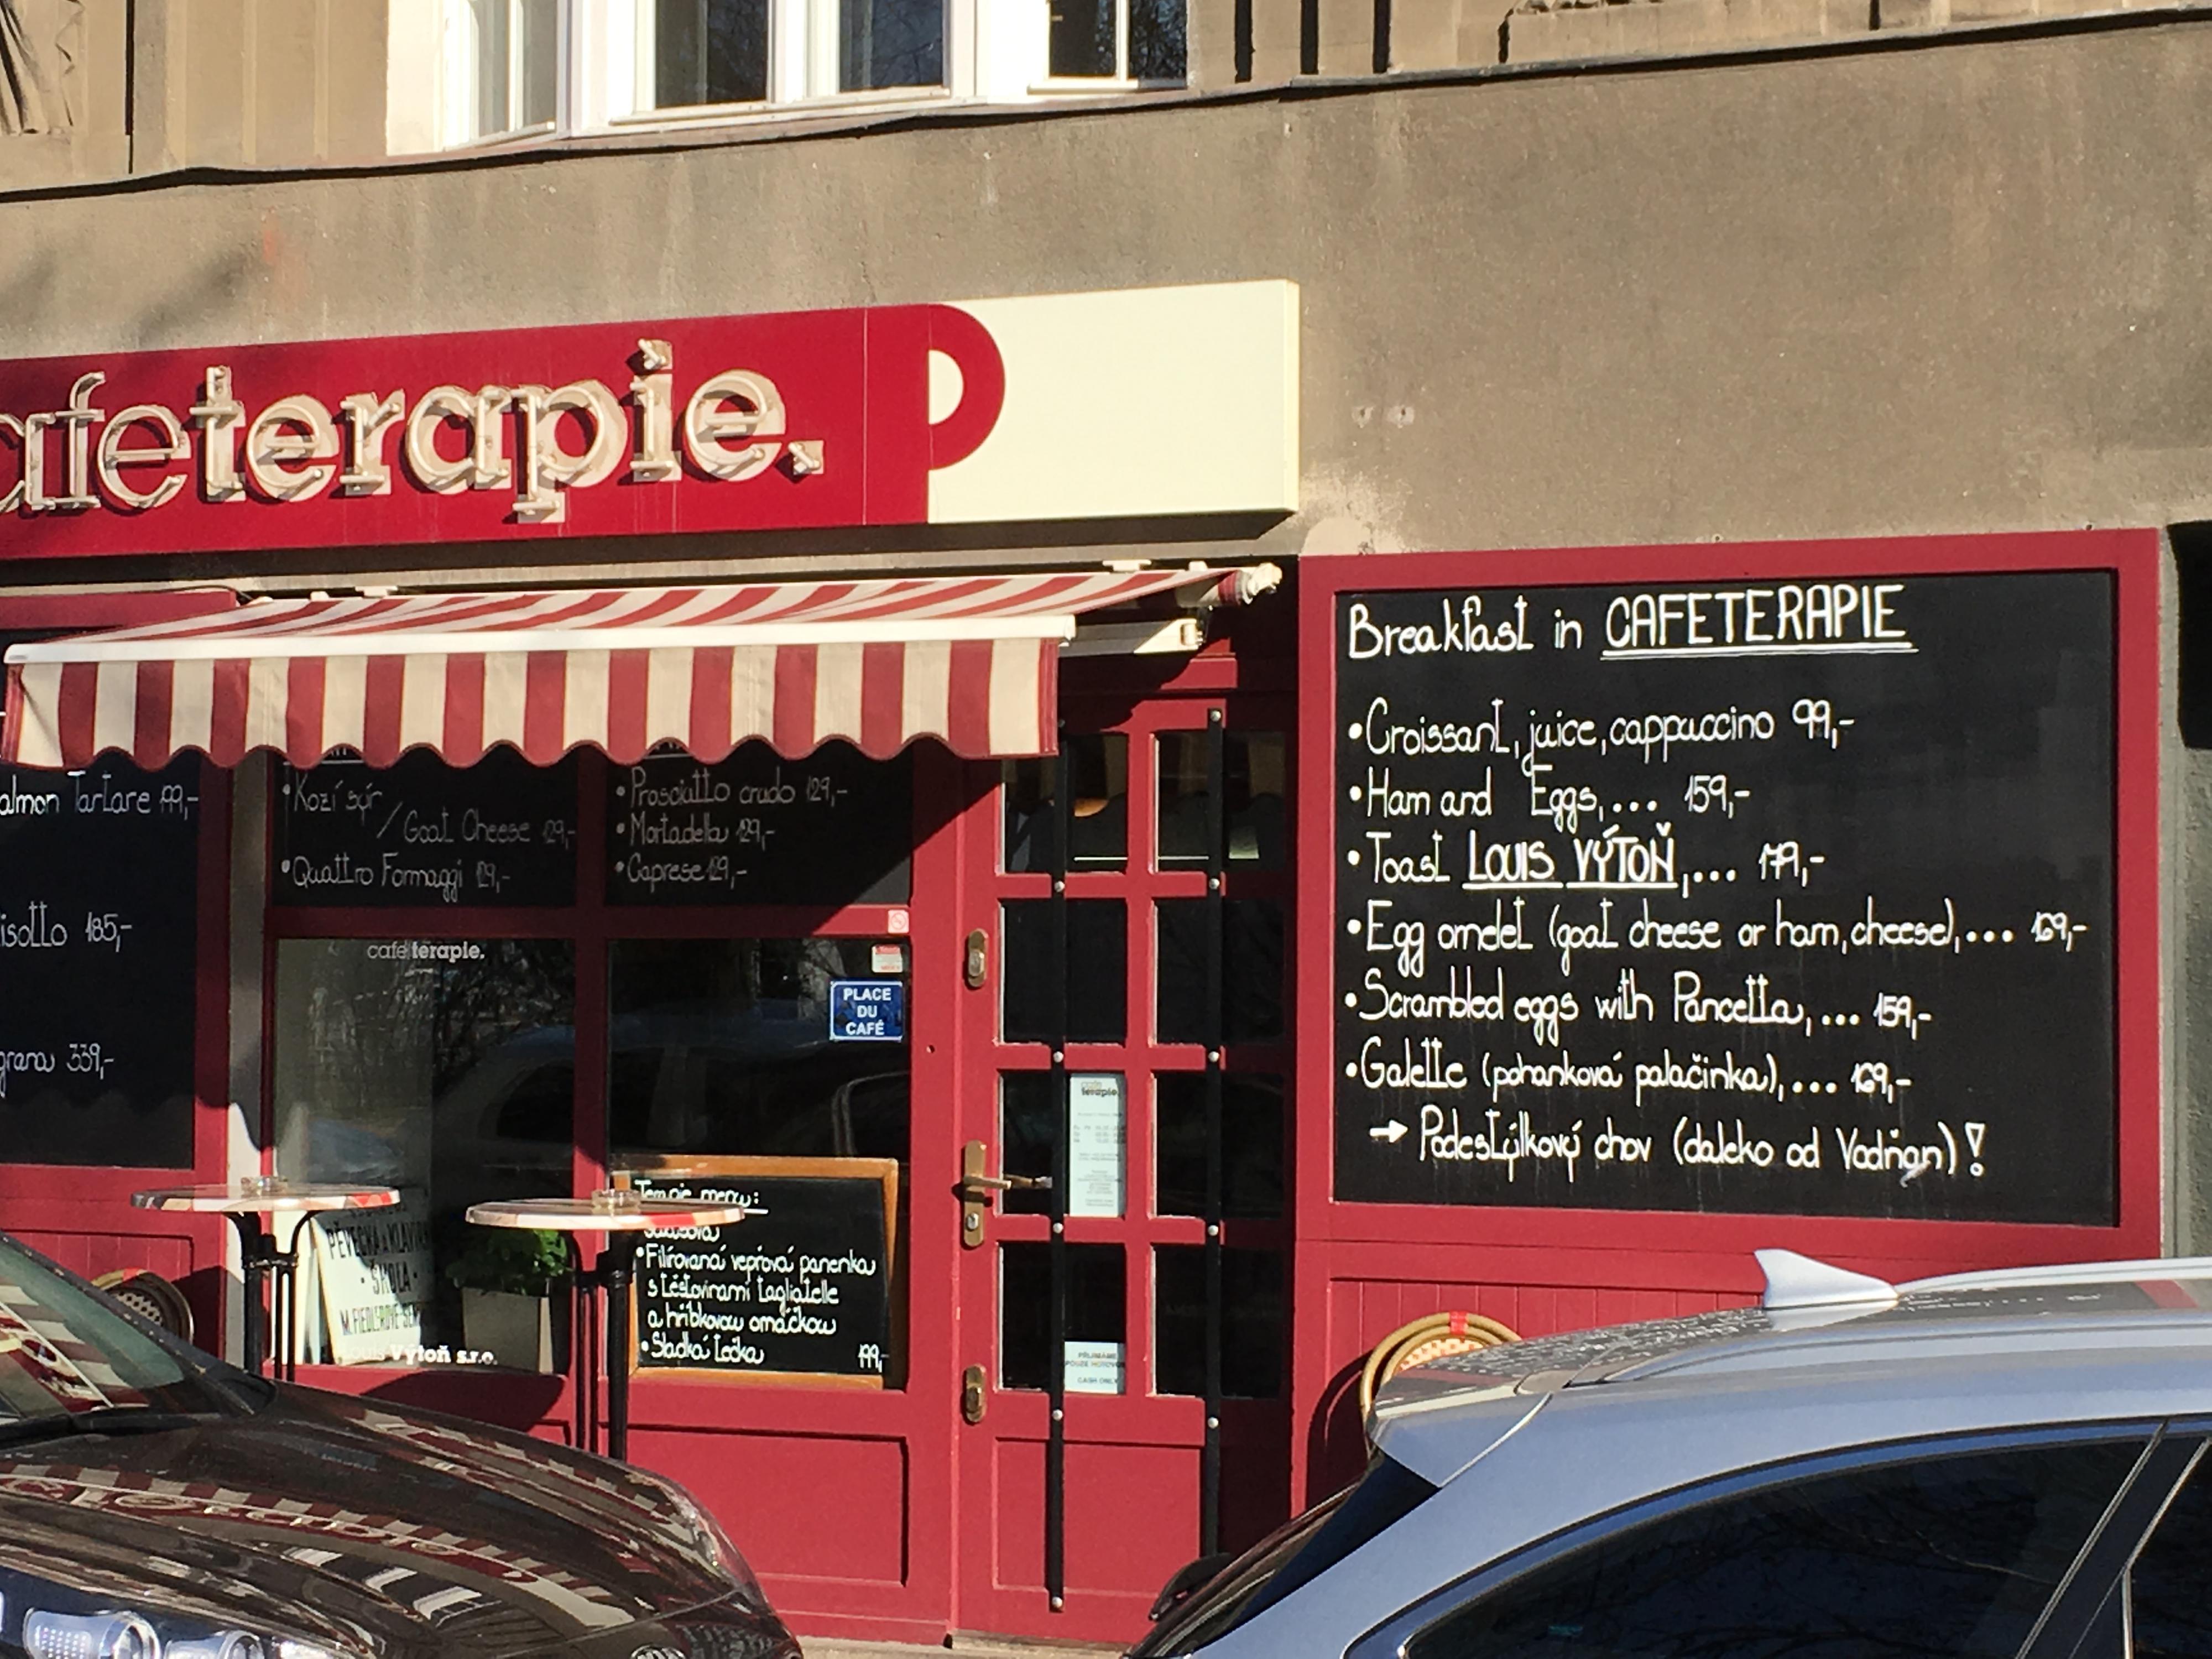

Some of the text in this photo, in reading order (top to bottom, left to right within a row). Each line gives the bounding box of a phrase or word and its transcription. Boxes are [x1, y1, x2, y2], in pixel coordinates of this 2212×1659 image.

[1349, 584, 1906, 659] Breakfast in CAFETERAPIE
[1792, 698, 1855, 749] 99,-
[67, 770, 151, 815] Tartare
[293, 772, 343, 812] Kozí
[404, 806, 454, 844] Goat
[461, 808, 530, 843] Cheese
[630, 766, 731, 808] Prosciutto
[739, 766, 796, 805] crudo
[1366, 765, 1431, 818] Ham
[1439, 765, 1493, 817] and
[1684, 774, 1751, 819] 159,-
[630, 812, 729, 847] Mortadella
[292, 852, 374, 888] Quattro
[627, 853, 705, 893] Caprese
[1365, 830, 1451, 884] Toast
[1468, 829, 1556, 881] LOUIS
[1, 901, 133, 953] isotto 185,-
[1366, 899, 1425, 978] Egg
[1438, 896, 1533, 951] omelet
[1549, 897, 1619, 977] (goat
[1629, 898, 1721, 950] cheese
[1738, 923, 1766, 947] or
[2031, 911, 2088, 952] 169,-
[843, 987, 892, 1001] PLACE
[857, 1005, 878, 1018] DU
[1358, 965, 1504, 1020] Scrambled
[1513, 992, 1579, 1047] eggs
[1594, 968, 1654, 1021] with
[1873, 992, 1932, 1040] 159,-
[846, 1019, 885, 1036] CAFÉ
[1360, 1035, 1468, 1089] Galette
[1482, 1049, 1623, 1104] (pohanková
[1851, 1062, 1912, 1104] 169,-
[1594, 1117, 1652, 1162] chov
[1672, 1116, 1775, 1167] (daleko
[1786, 1126, 1820, 1168] od
[800, 1248, 876, 1285] panenka
[647, 1279, 659, 1298] s
[647, 1310, 664, 1328] a
[651, 1331, 711, 1360] Sladká
